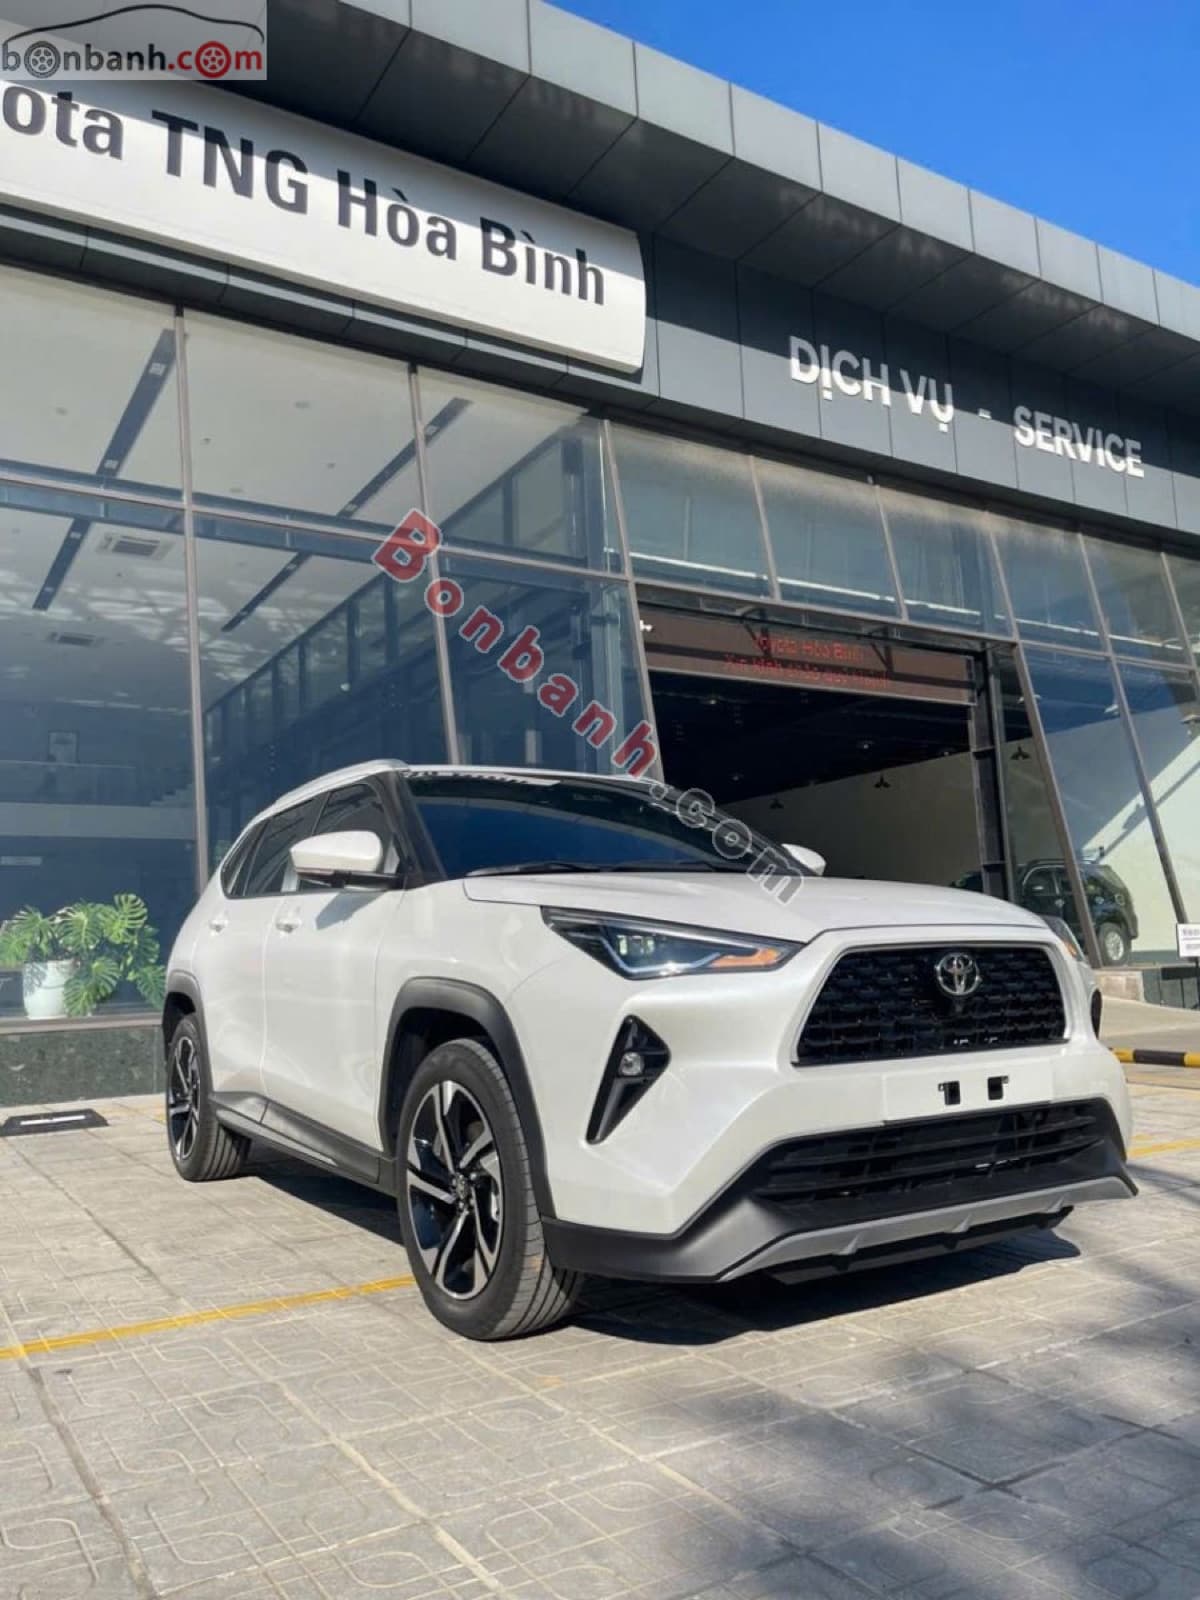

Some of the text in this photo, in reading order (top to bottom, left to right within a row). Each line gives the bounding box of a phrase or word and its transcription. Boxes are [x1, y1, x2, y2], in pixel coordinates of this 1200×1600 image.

[2, 85, 605, 306] ota TNG Hòa Bình
[789, 335, 1145, 478] DỊCH VỤ - SERVICE
